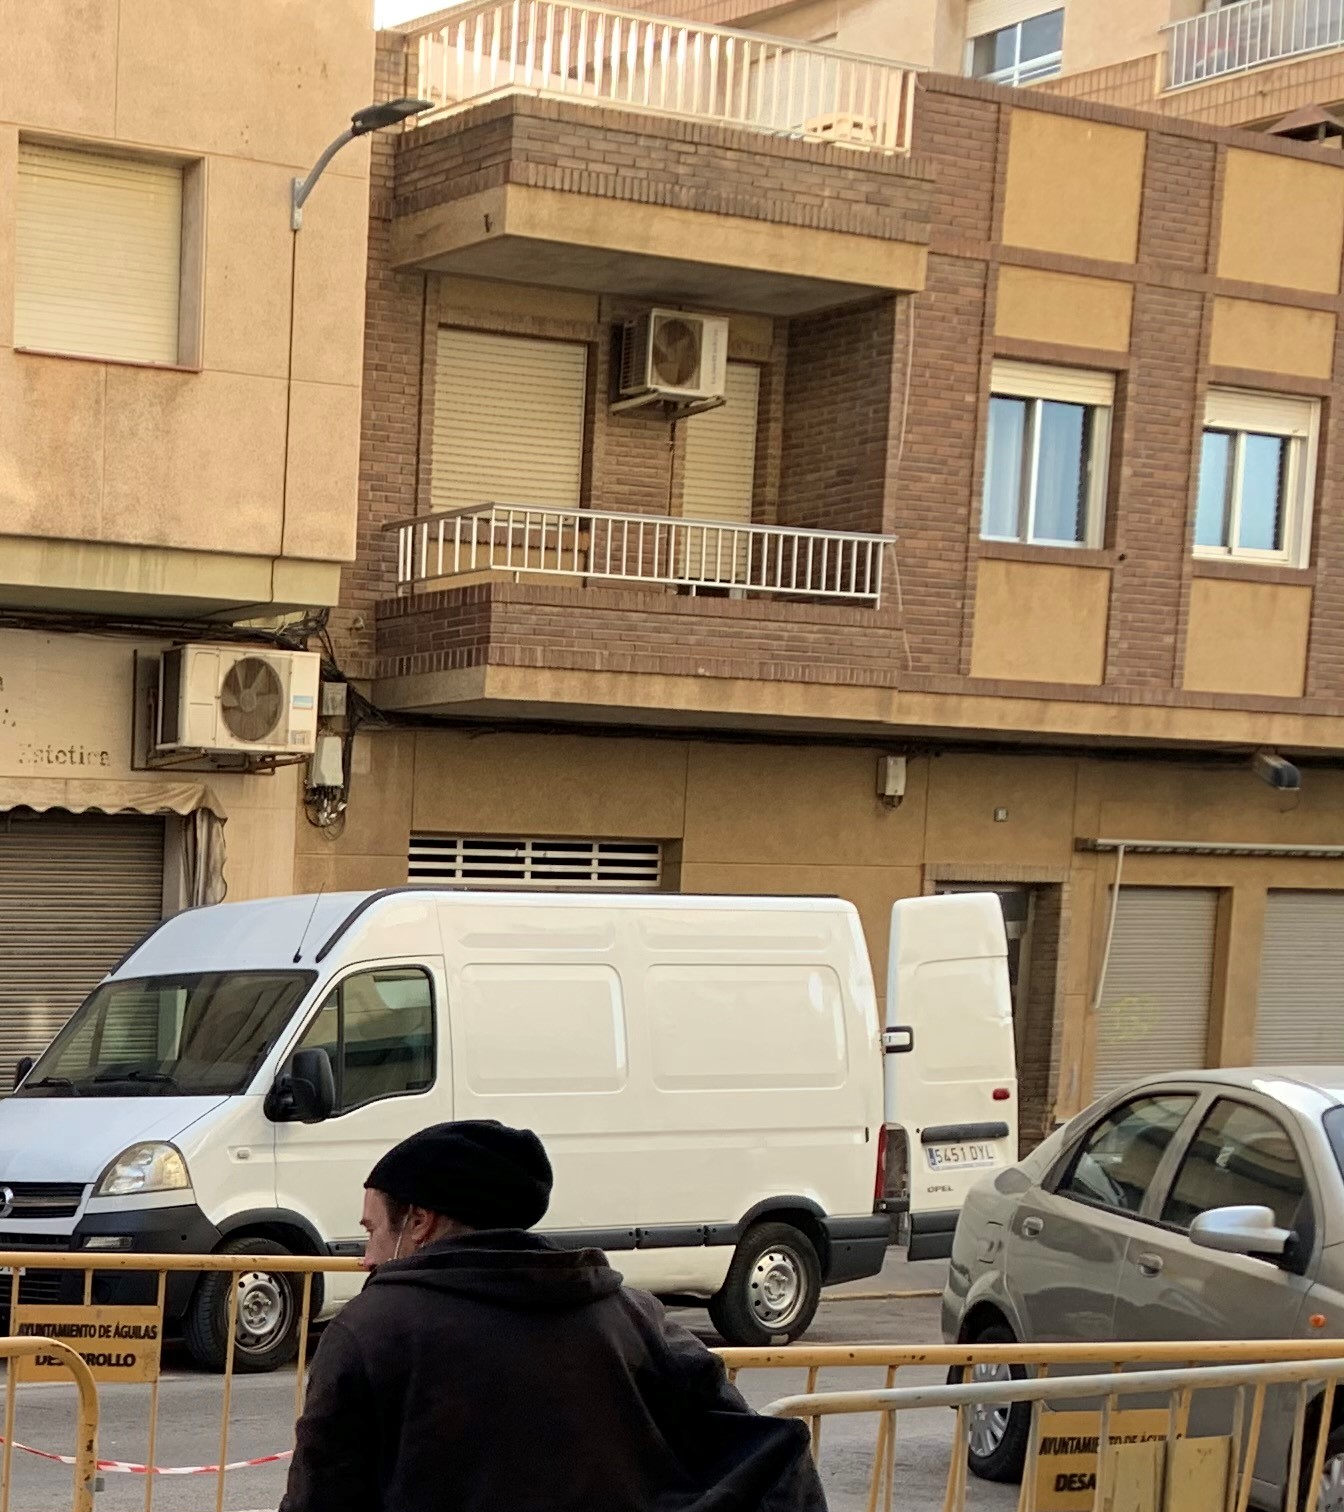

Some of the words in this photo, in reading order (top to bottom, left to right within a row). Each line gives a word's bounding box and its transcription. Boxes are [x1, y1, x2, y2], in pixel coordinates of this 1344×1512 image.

[934, 1146, 967, 1163] 5451
[969, 1144, 994, 1161] DYL
[927, 1185, 954, 1193] OPEL
[17, 1322, 97, 1338] AYUNTAMIENTO
[98, 1324, 111, 1338] DE
[113, 1322, 158, 1340] ÁGUILAS
